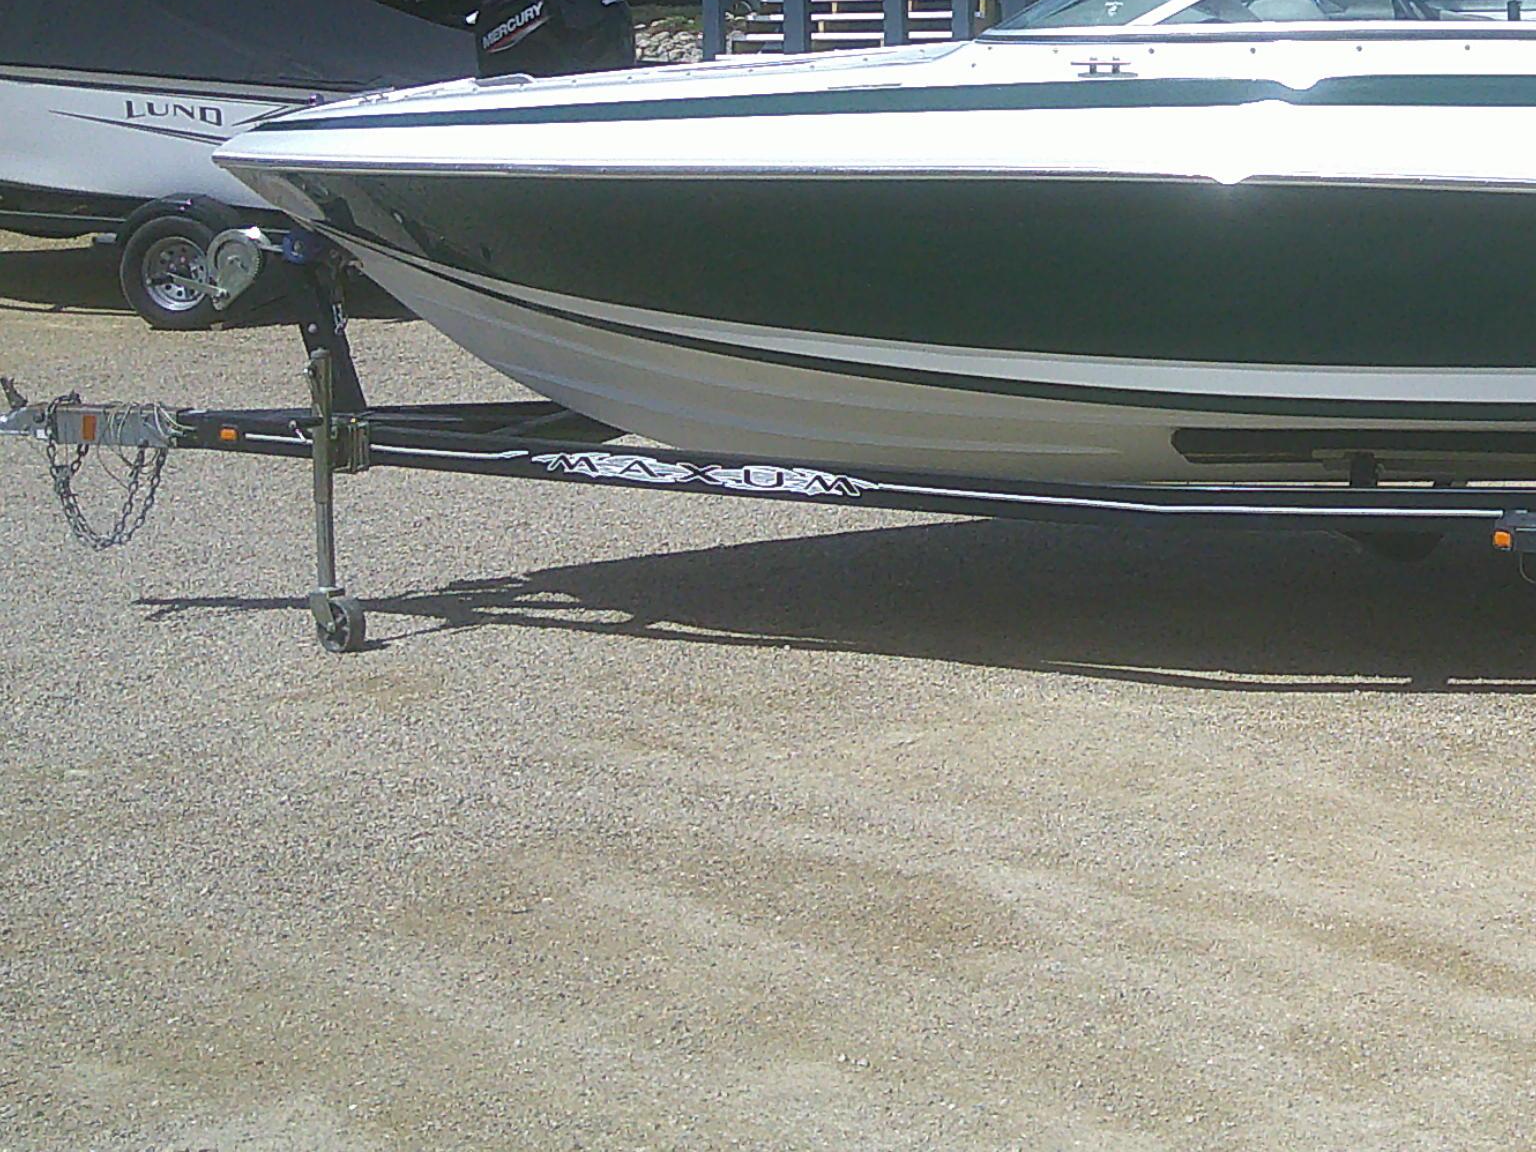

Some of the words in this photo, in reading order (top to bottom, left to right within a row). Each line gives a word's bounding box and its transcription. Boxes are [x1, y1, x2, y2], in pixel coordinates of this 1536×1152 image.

[482, 0, 545, 49] MERCURY
[125, 100, 222, 127] LUND
[548, 452, 860, 497] MAXUM
